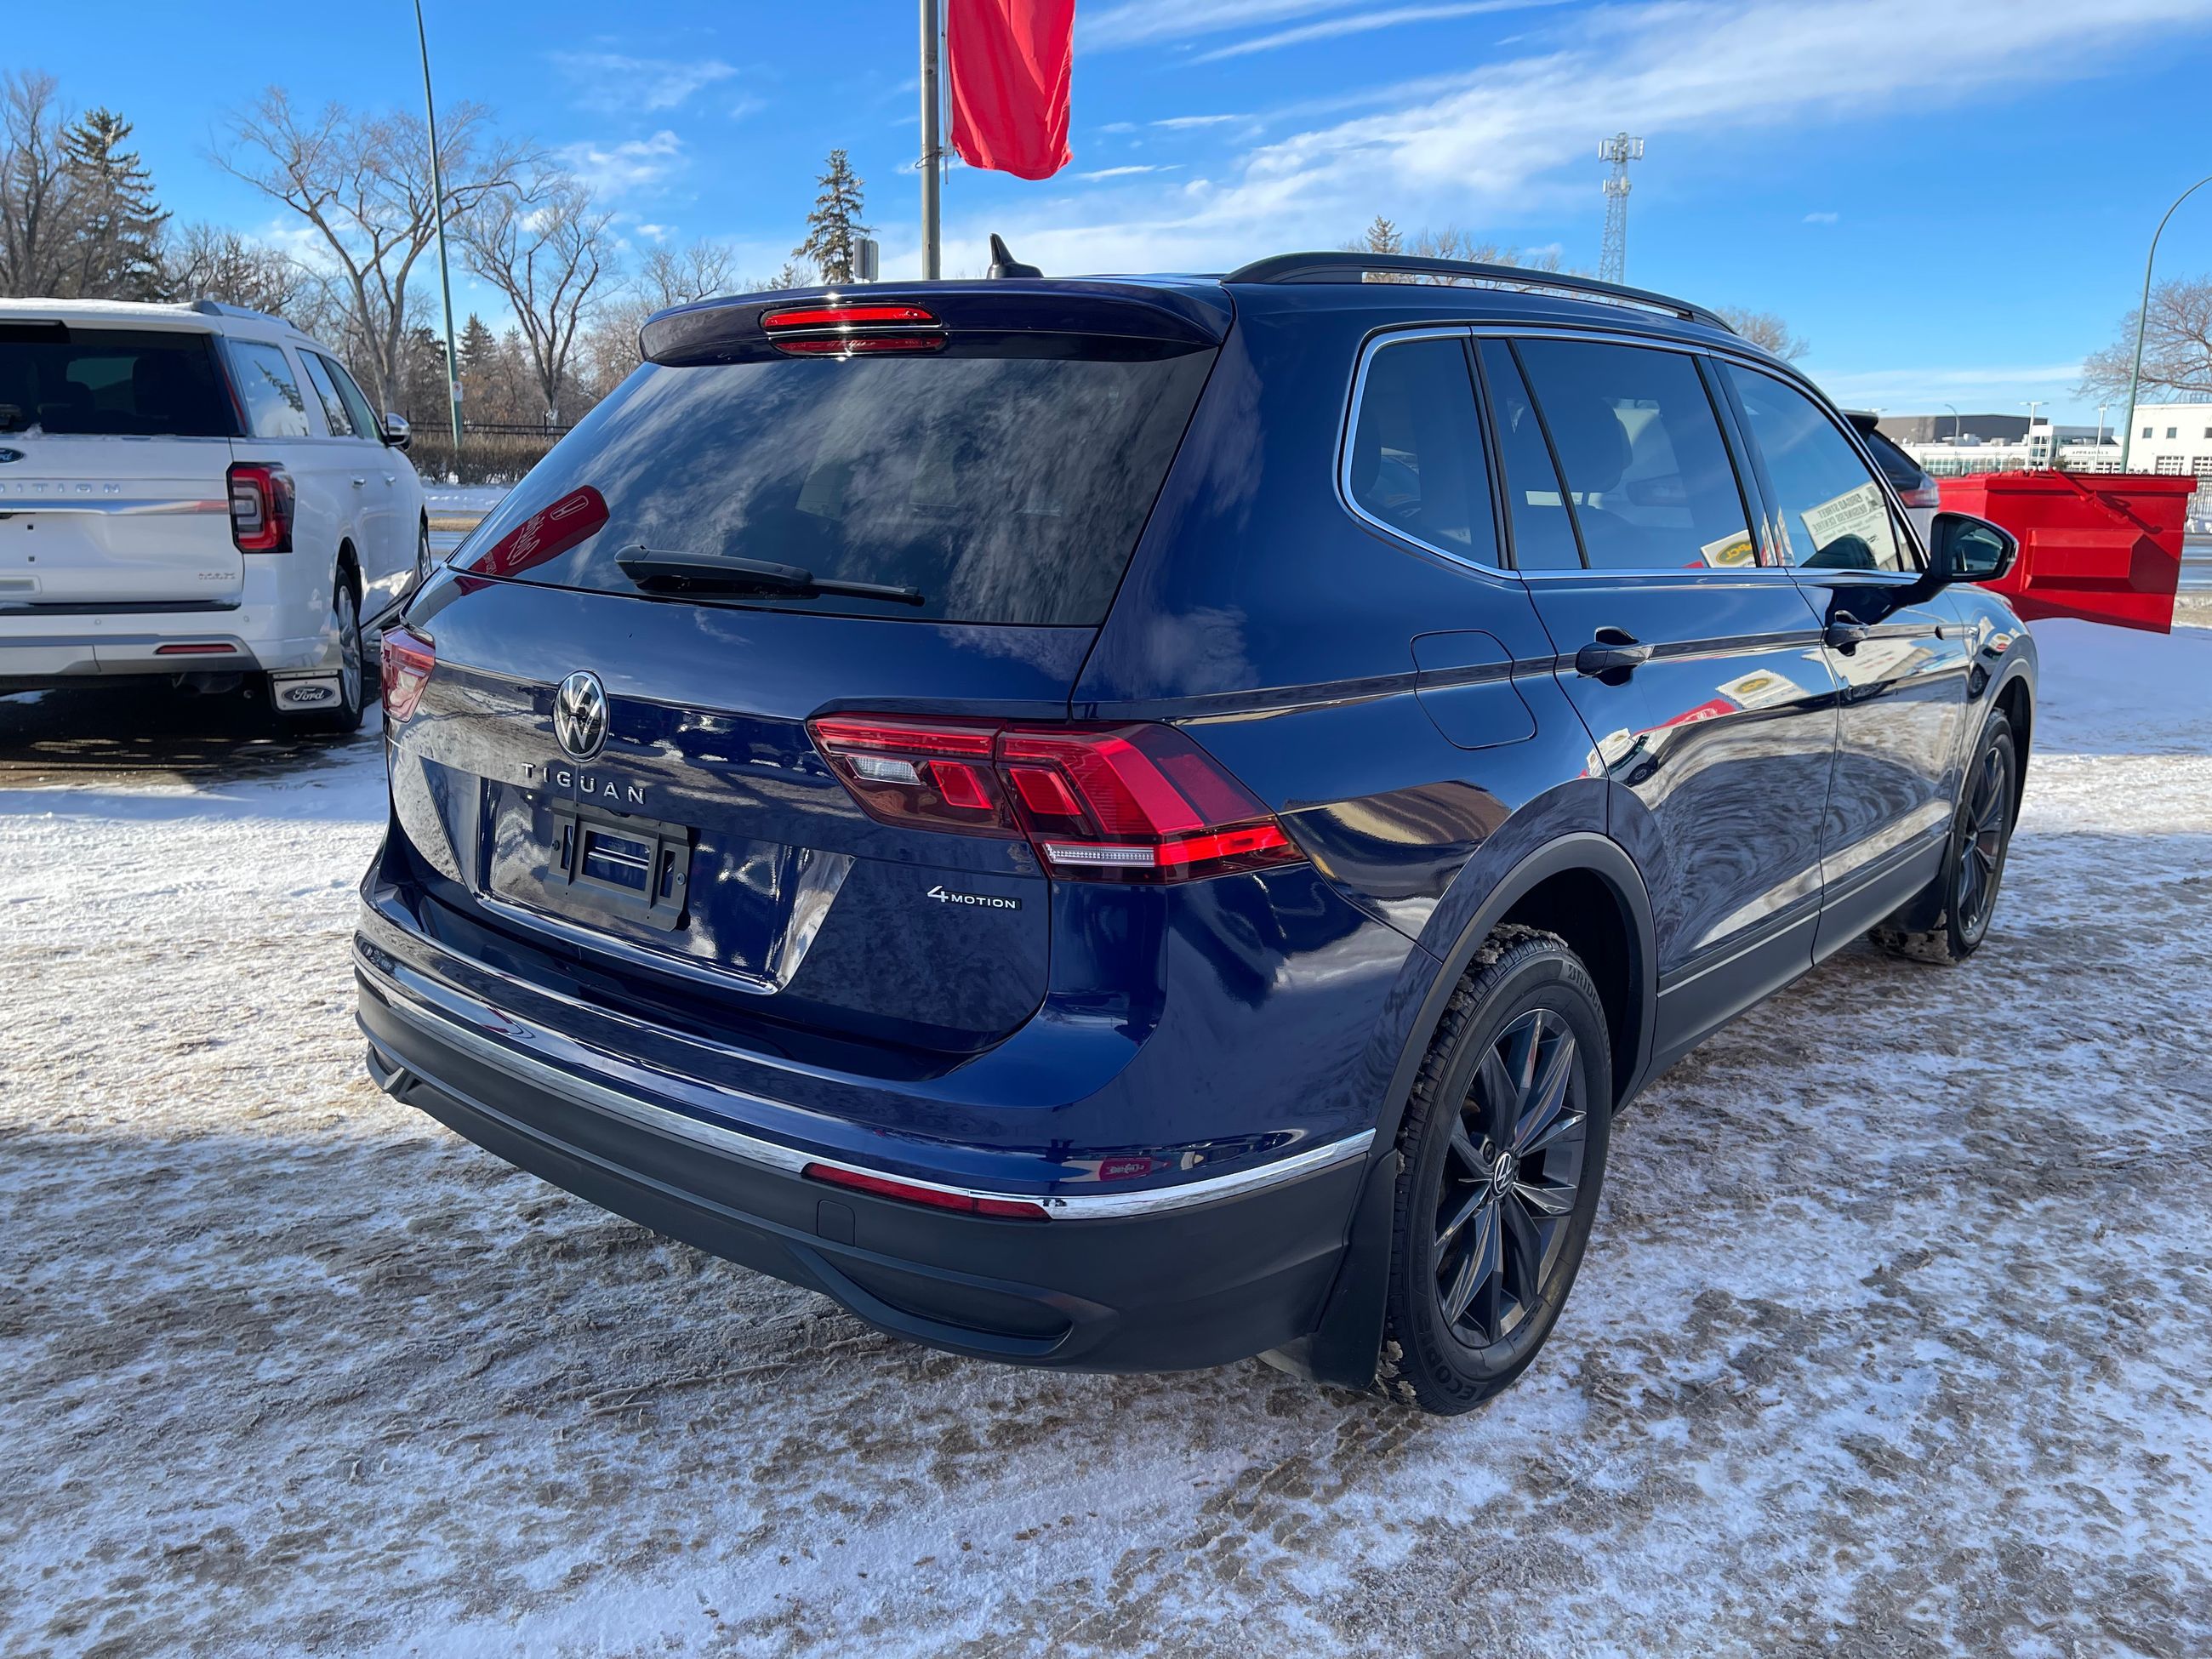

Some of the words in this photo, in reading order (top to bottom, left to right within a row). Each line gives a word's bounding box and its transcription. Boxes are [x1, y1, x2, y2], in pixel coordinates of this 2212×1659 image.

[0, 482, 120, 493] ITION
[292, 687, 325, 702] Ford
[521, 762, 647, 805] TIGUAN
